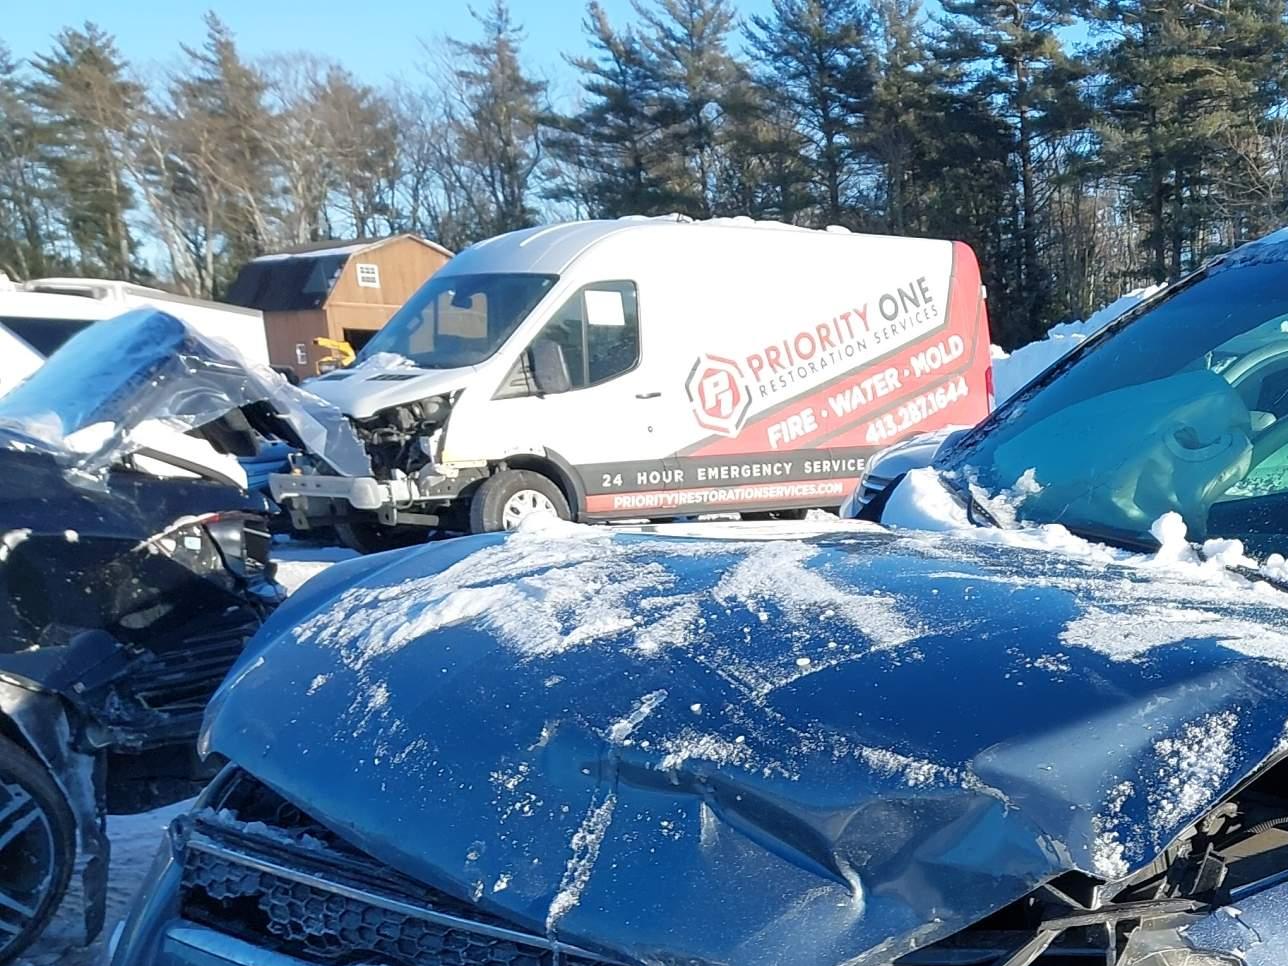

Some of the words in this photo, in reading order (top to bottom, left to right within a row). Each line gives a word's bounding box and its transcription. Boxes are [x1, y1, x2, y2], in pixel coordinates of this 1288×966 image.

[746, 303, 870, 383] PRIORITY
[879, 276, 933, 322] ONE
[759, 339, 868, 399] RESTORATION
[873, 304, 939, 345] SERVICES
[766, 407, 819, 449] FIRE
[828, 367, 903, 417] WATER
[909, 335, 965, 378] MOLD
[864, 375, 969, 443] 413.287.1644
[602, 473, 623, 487] 24
[636, 469, 685, 485] HOUR
[697, 462, 793, 481] EMERGENCY
[804, 458, 865, 474] SERVICE
